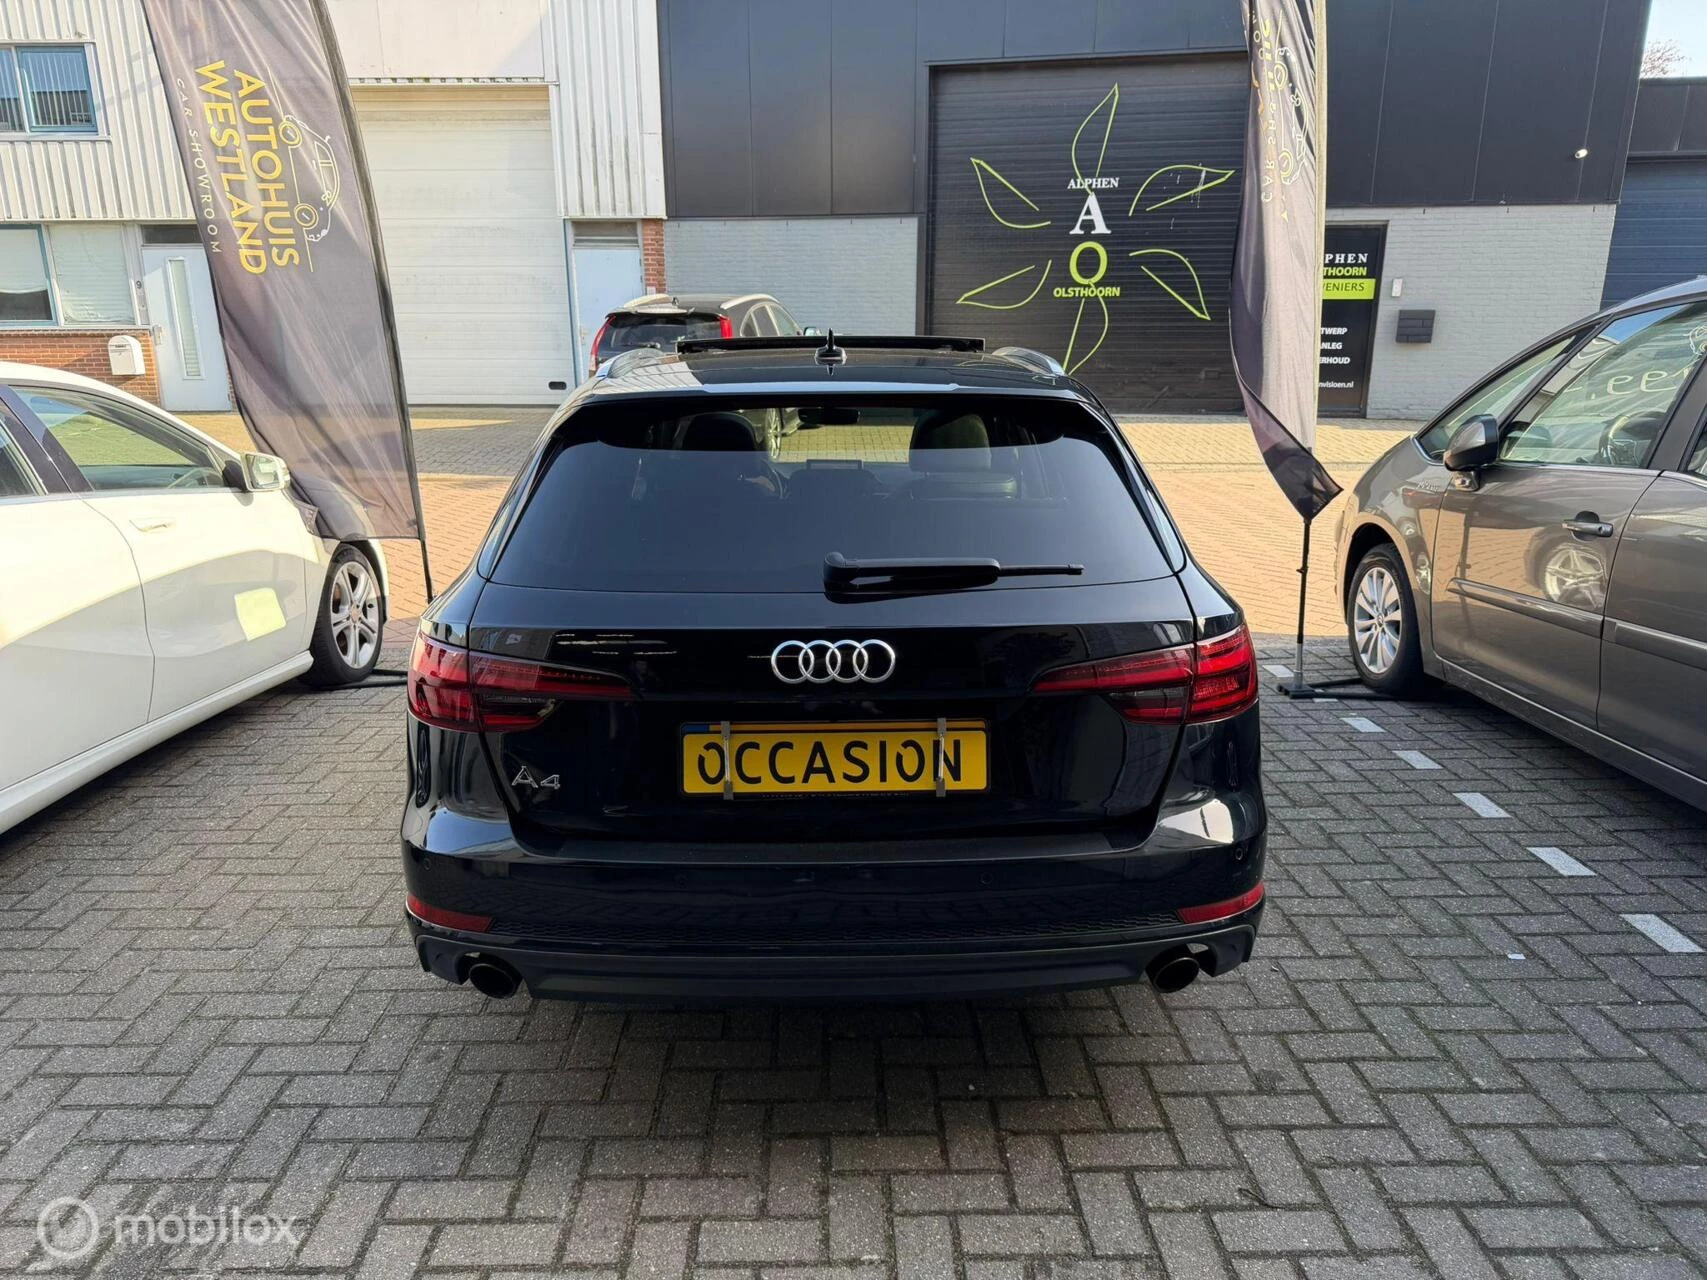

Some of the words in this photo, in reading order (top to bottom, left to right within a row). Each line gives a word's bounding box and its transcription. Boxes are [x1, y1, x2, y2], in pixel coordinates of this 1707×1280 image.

[176, 78, 193, 117] CAR
[188, 128, 222, 253] SHOWROOM
[195, 59, 268, 275] WESTLAND
[233, 69, 300, 267] AUTOHUIS
[1067, 177, 1120, 189] ALPHEN
[1069, 191, 1112, 235] A
[1069, 241, 1108, 285] O
[1053, 286, 1121, 298] OLSTHOORN
[1320, 342, 1343, 350] NLEG
[511, 765, 560, 790] A4
[697, 738, 962, 785] OCCASION
